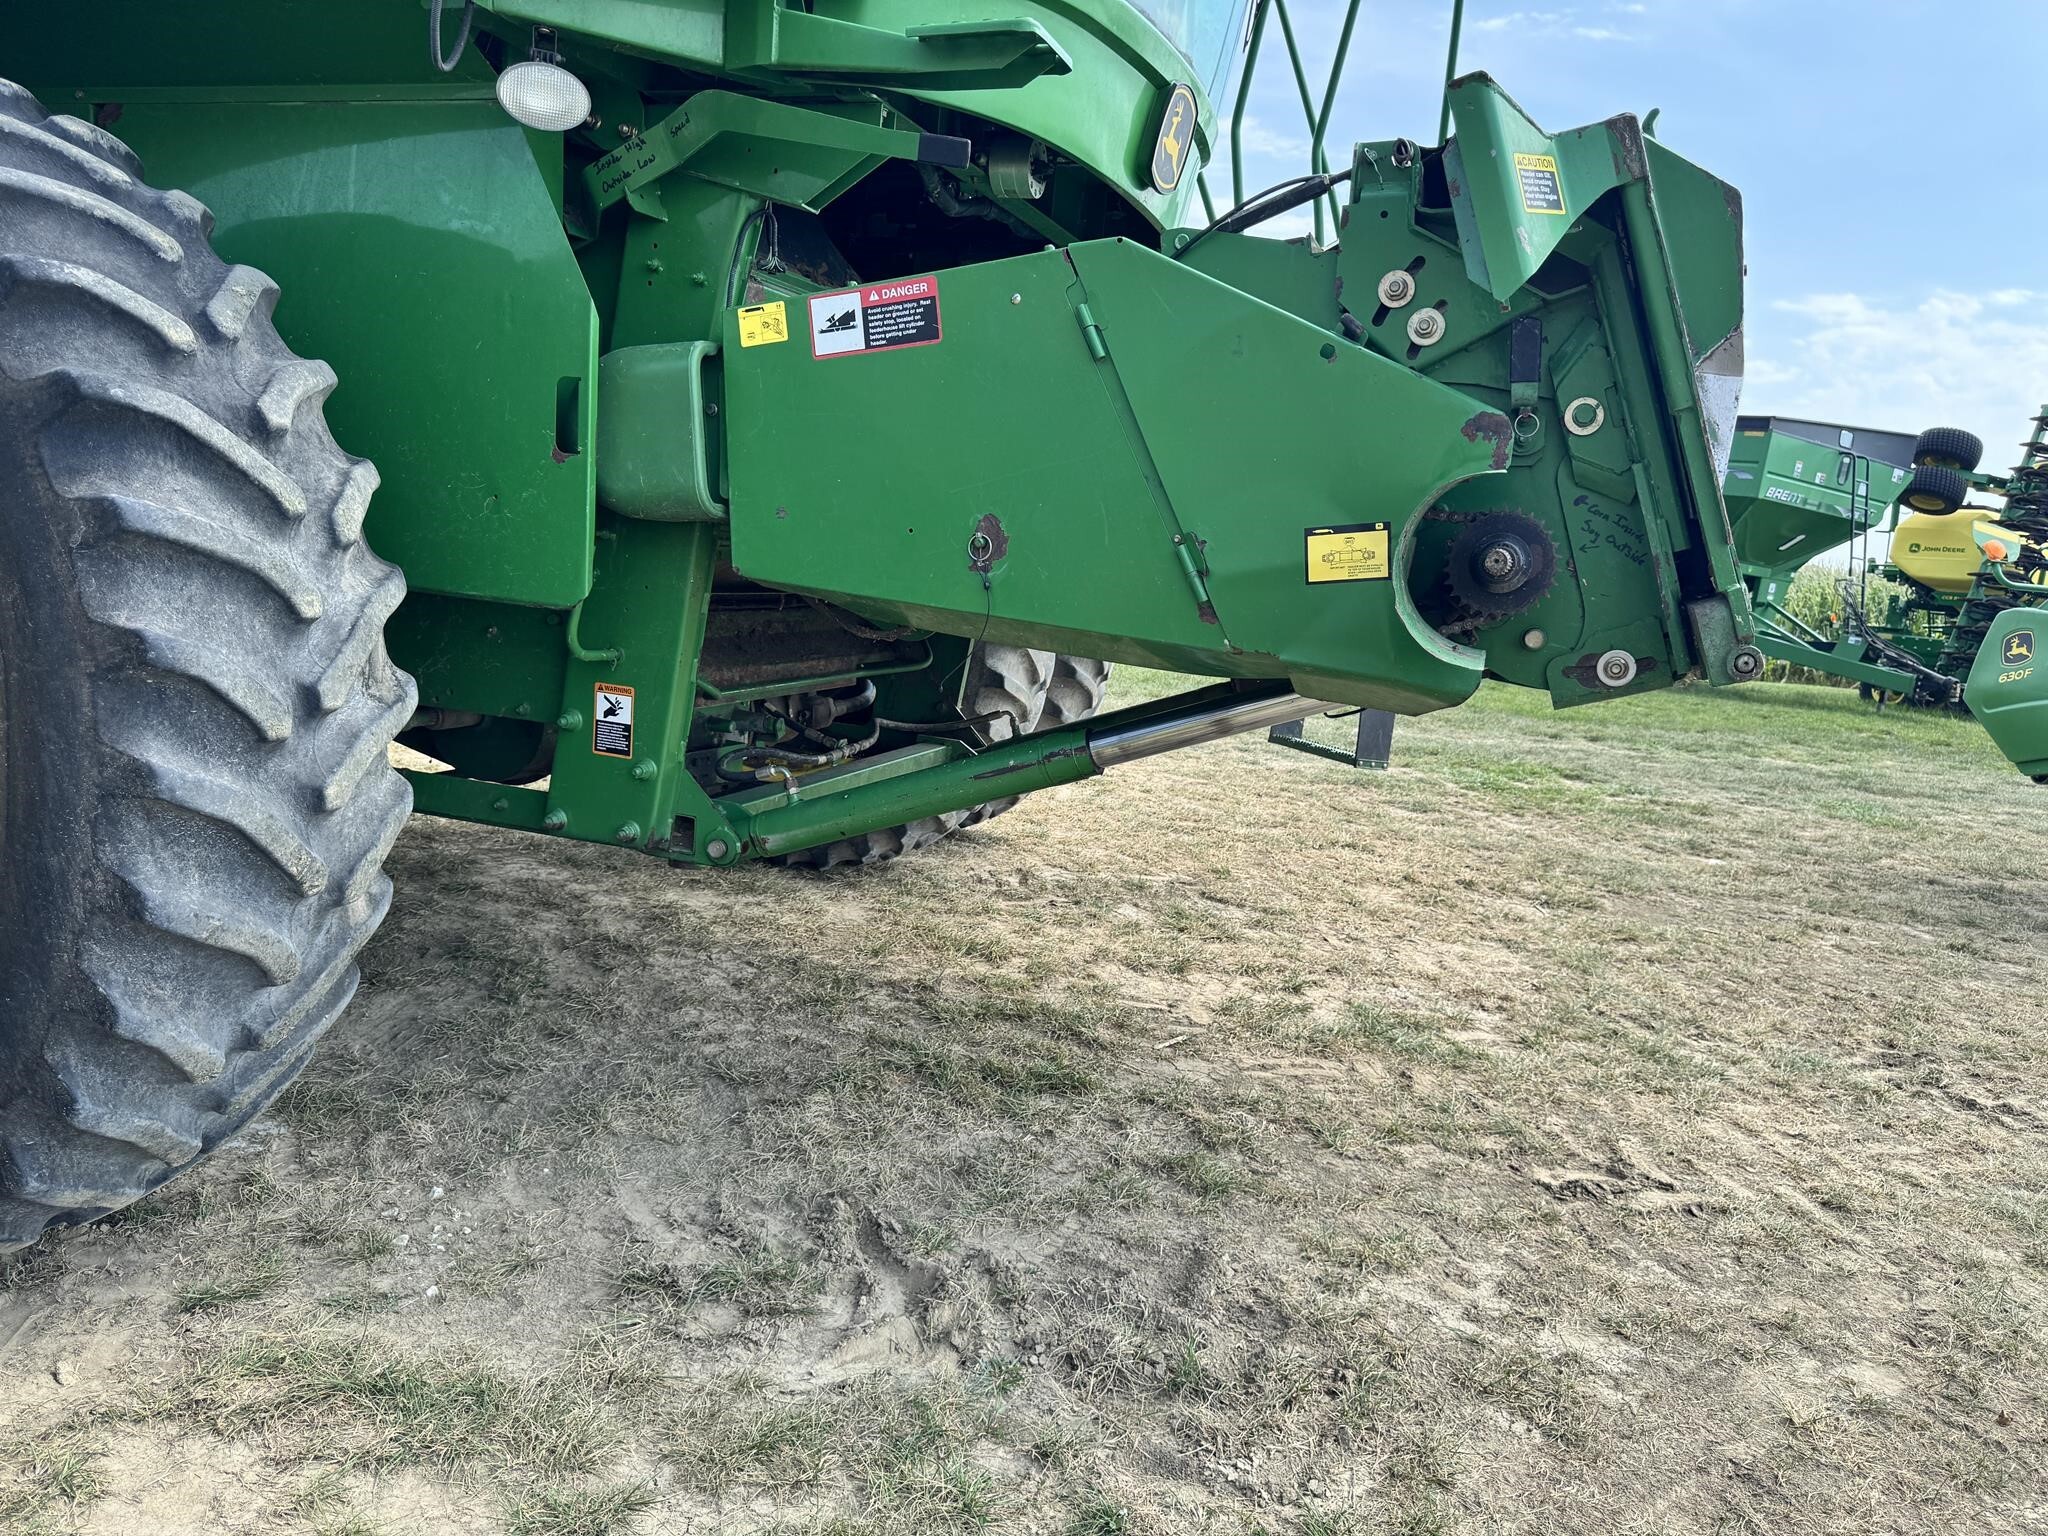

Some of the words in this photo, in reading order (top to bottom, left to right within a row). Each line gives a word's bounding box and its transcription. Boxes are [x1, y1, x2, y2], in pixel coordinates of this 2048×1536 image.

[624, 137, 647, 153] High
[637, 154, 656, 170] Low
[1521, 156, 1554, 169] CAUTION
[882, 282, 928, 299] DANGER
[882, 304, 903, 312] crushing
[892, 310, 909, 318] ground
[869, 325, 898, 333] feederhouse
[906, 321, 925, 329] cylinder
[869, 332, 885, 340] before
[1765, 486, 1805, 504] BRENT
[1587, 504, 1610, 522] Corn
[1581, 519, 1601, 544] Soy
[1998, 667, 2034, 683] 630F
[604, 685, 632, 695] WARNING
